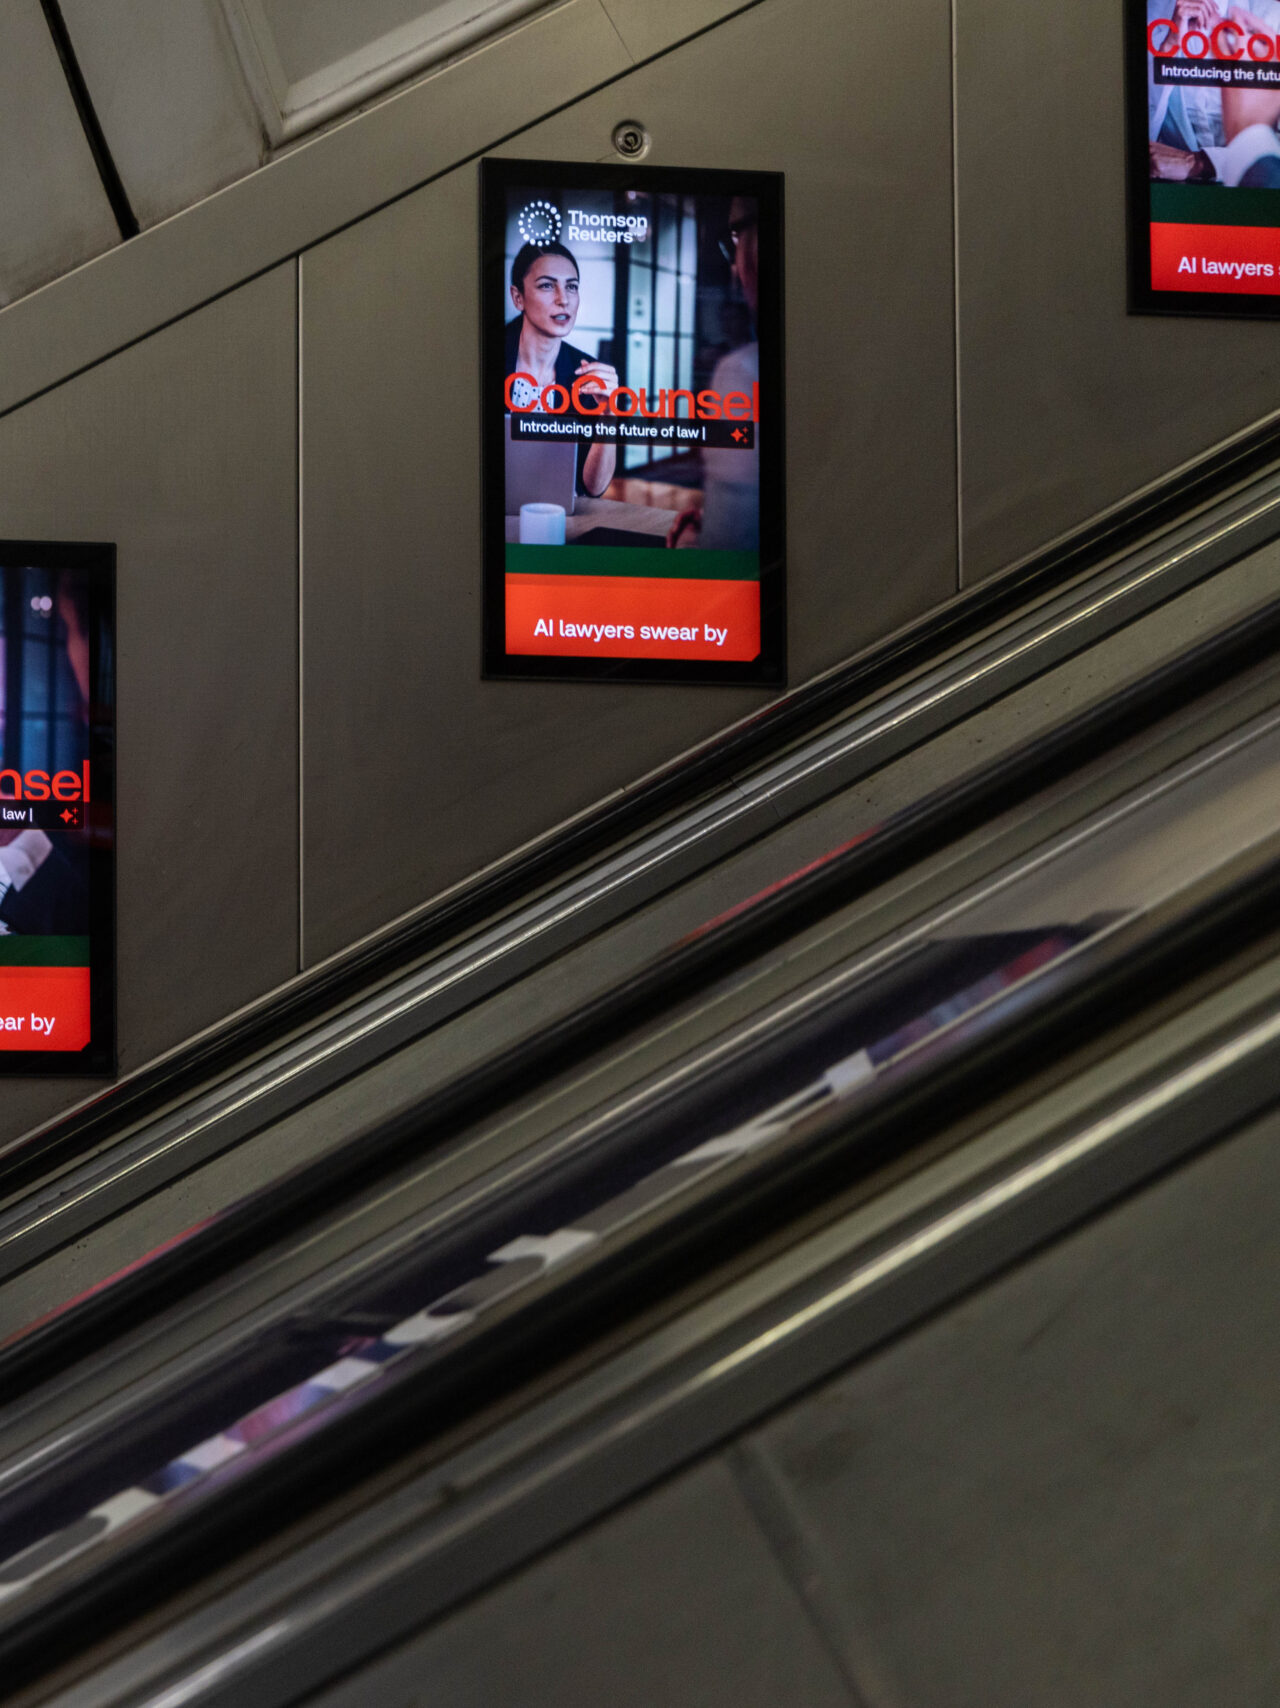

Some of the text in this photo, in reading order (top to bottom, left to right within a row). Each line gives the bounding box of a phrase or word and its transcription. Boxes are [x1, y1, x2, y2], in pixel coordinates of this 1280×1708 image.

[1147, 18, 1280, 62] CoCo
[1161, 64, 1232, 82] Introducing
[1234, 68, 1255, 80] the
[568, 209, 648, 228] Thomson
[1177, 256, 1197, 274] AI
[1201, 257, 1274, 280] lawyers
[504, 372, 760, 423] CoCounsel
[520, 419, 700, 439] Introducing the future of law
[533, 618, 728, 646] AI lawyers swear by
[2, 807, 27, 821] law
[30, 1012, 56, 1036] by
